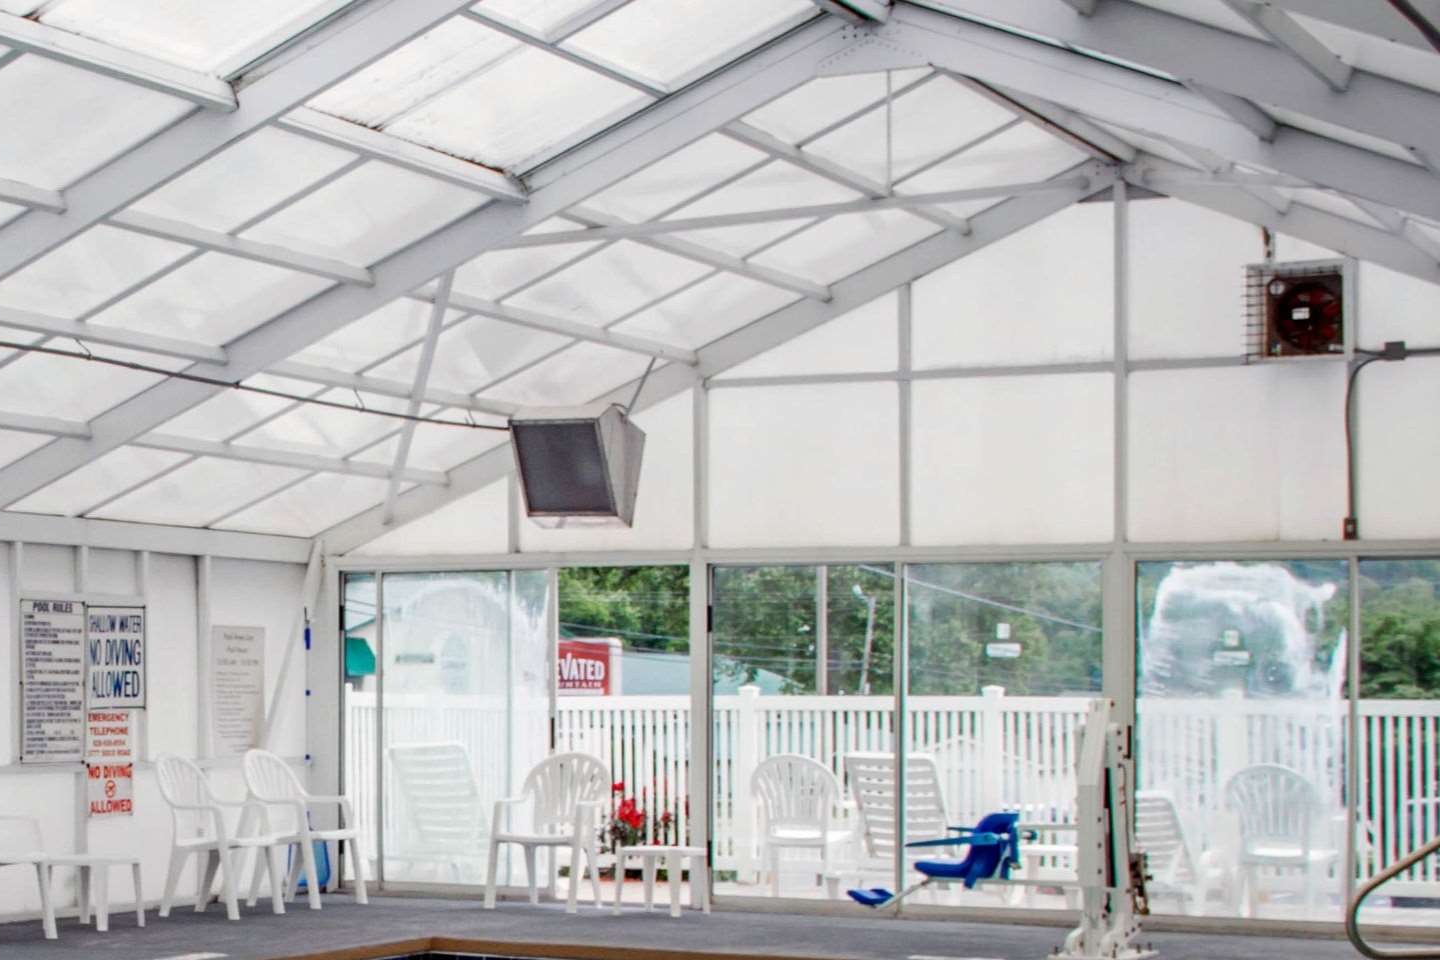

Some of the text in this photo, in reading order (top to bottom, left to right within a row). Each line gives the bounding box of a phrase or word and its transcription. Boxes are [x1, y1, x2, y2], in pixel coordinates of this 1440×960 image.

[33, 602, 73, 613] POOL RULES
[89, 614, 141, 633] SHALLOW WATER
[90, 639, 142, 666] NO DIVING
[92, 670, 141, 699] ALLOWED
[87, 713, 128, 722] EMERGENCY
[89, 727, 128, 736] TELEPHONE
[87, 765, 132, 779] NO DIVING
[90, 799, 132, 814] ALLOWED
